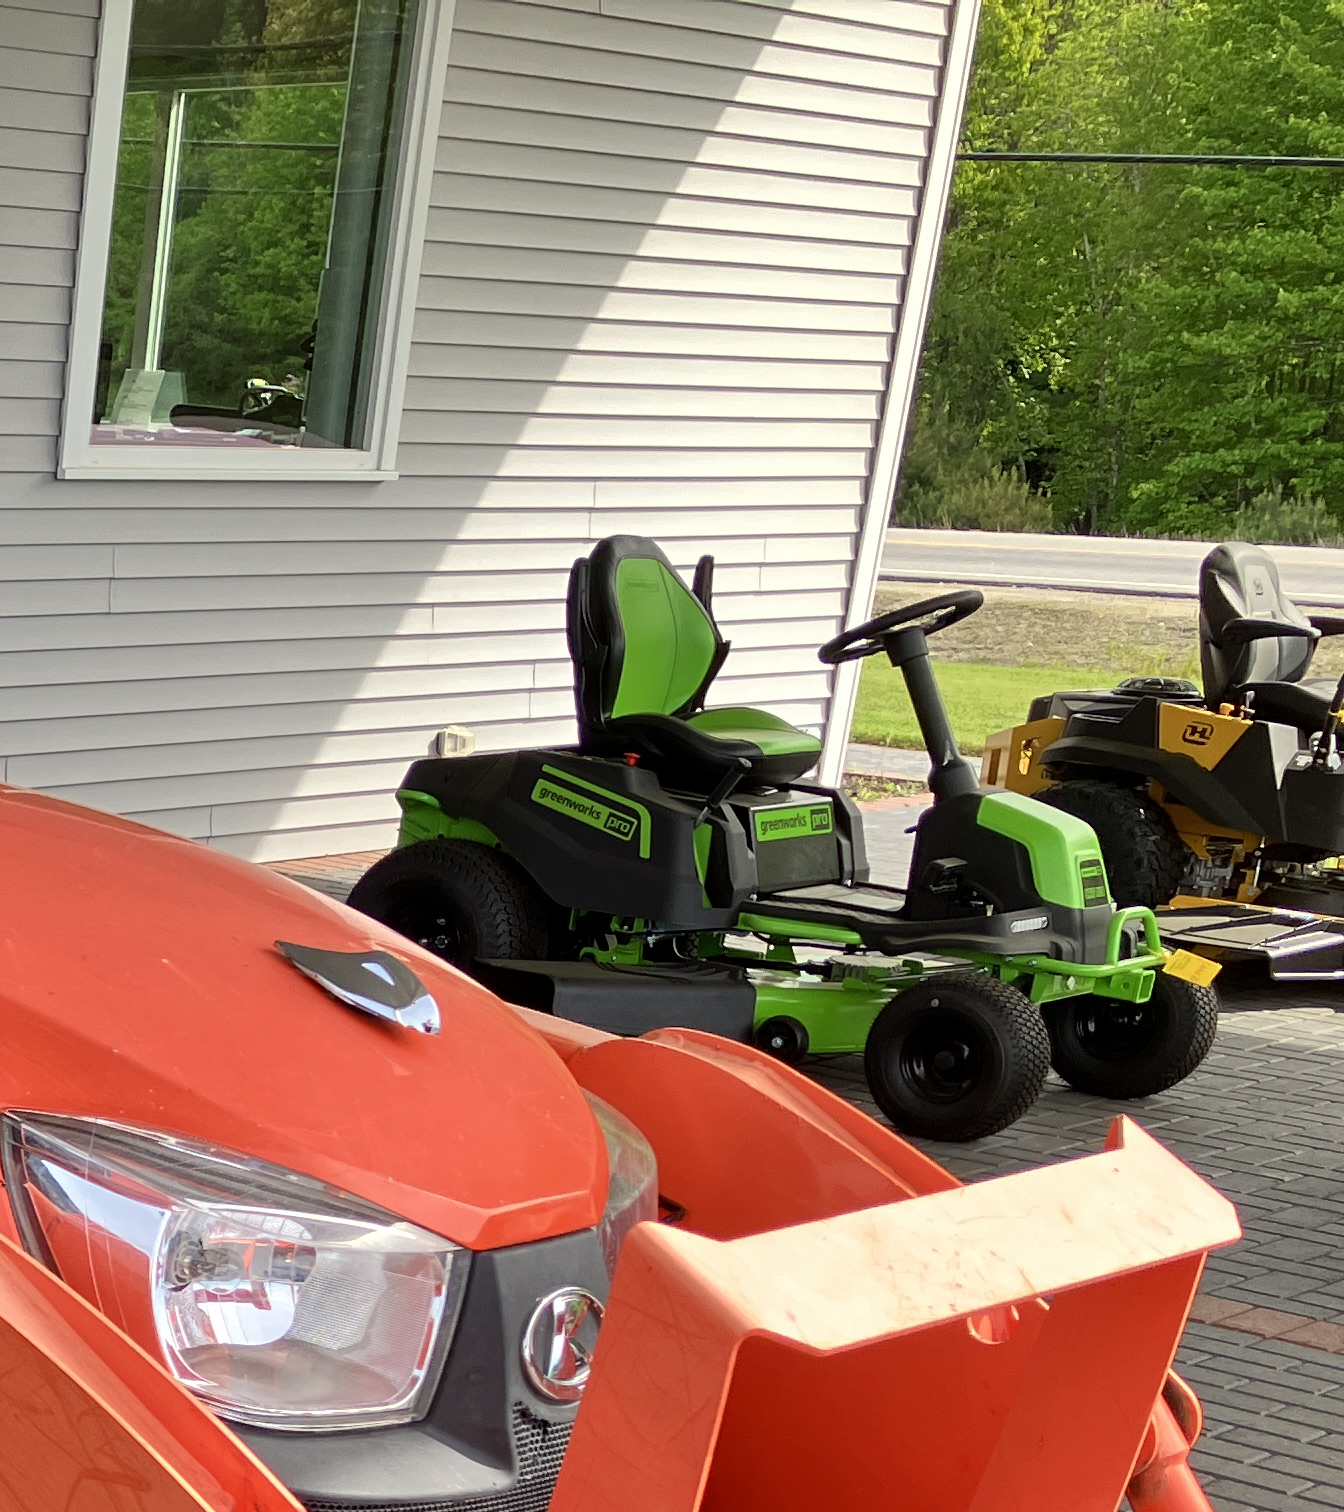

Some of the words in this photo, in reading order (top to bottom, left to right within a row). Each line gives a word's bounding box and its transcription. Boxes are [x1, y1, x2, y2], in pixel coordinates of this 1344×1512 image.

[539, 786, 602, 820] greenworks
[606, 814, 632, 834] pro
[760, 814, 807, 833] greenworks
[813, 813, 828, 829] pro
